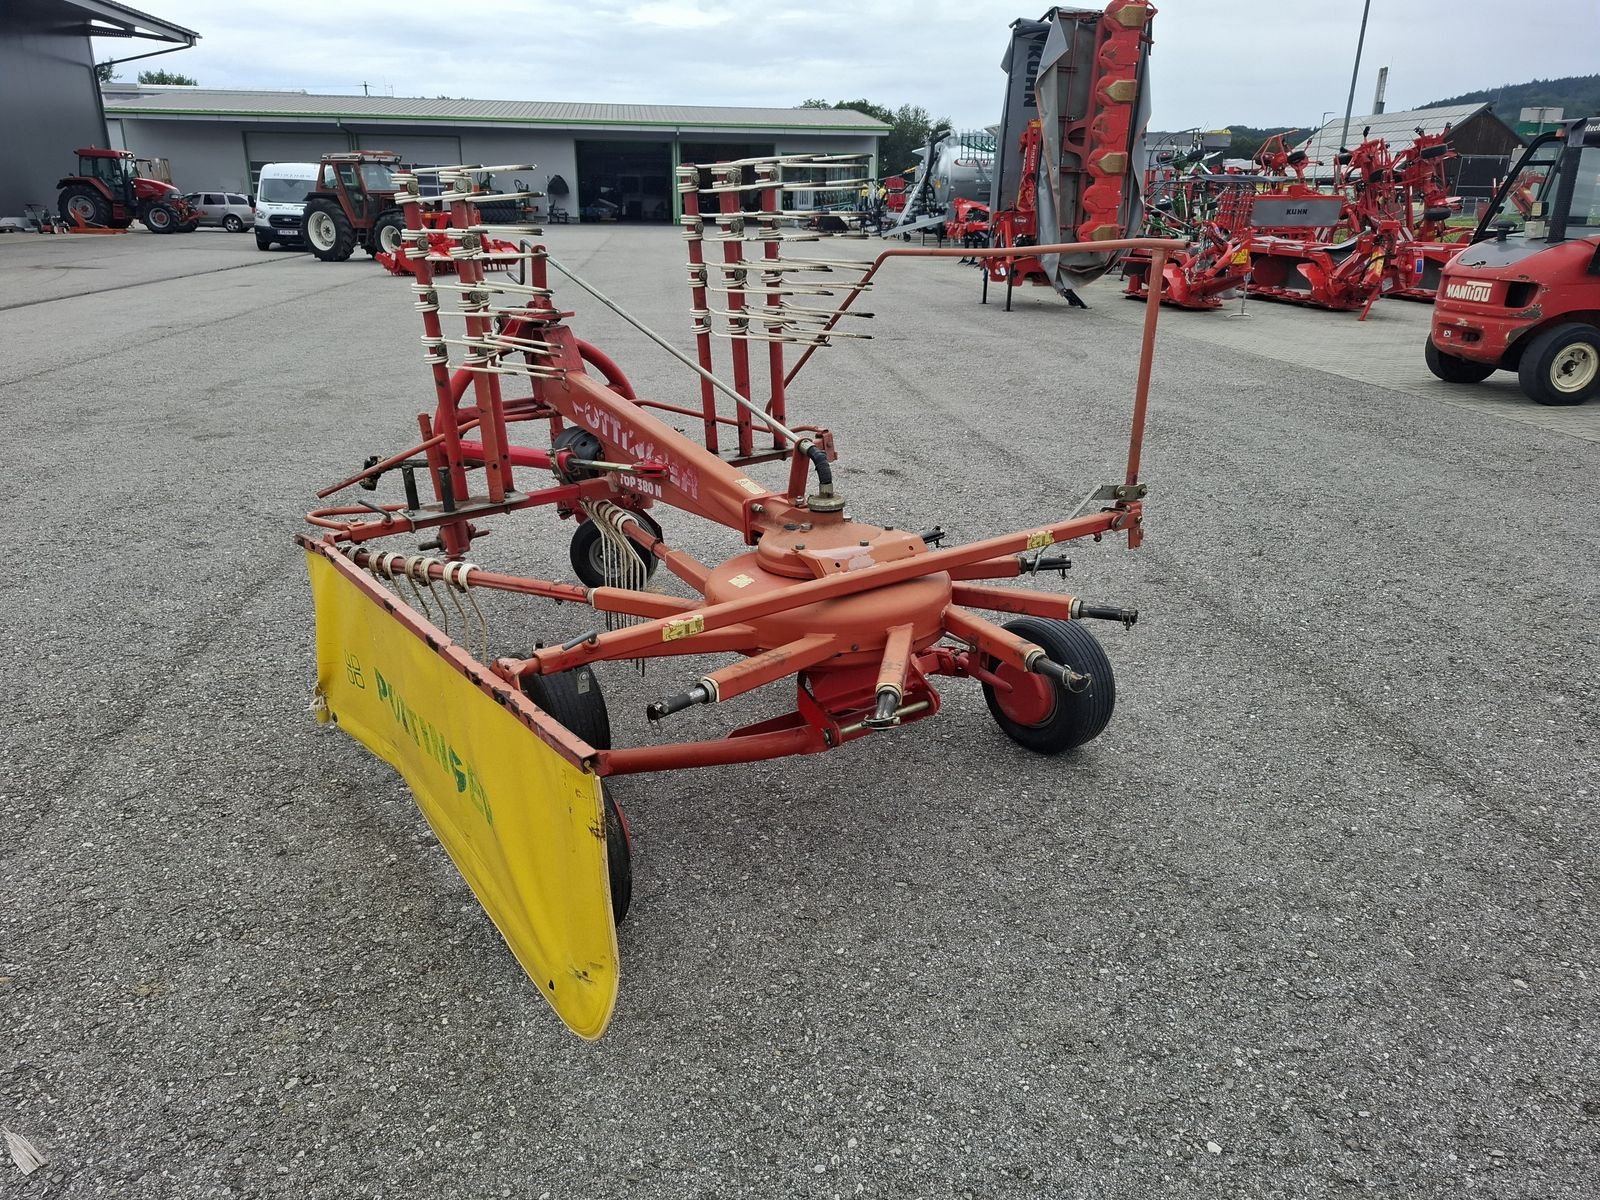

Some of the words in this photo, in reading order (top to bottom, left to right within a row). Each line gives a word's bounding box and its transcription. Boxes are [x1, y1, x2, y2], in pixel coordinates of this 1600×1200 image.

[1024, 44, 1044, 108] KUHN
[1285, 208, 1308, 216] KUHN
[1446, 280, 1493, 302] MANITOU
[620, 473, 636, 488] TOP
[637, 477, 654, 495] 380
[655, 484, 662, 498] N
